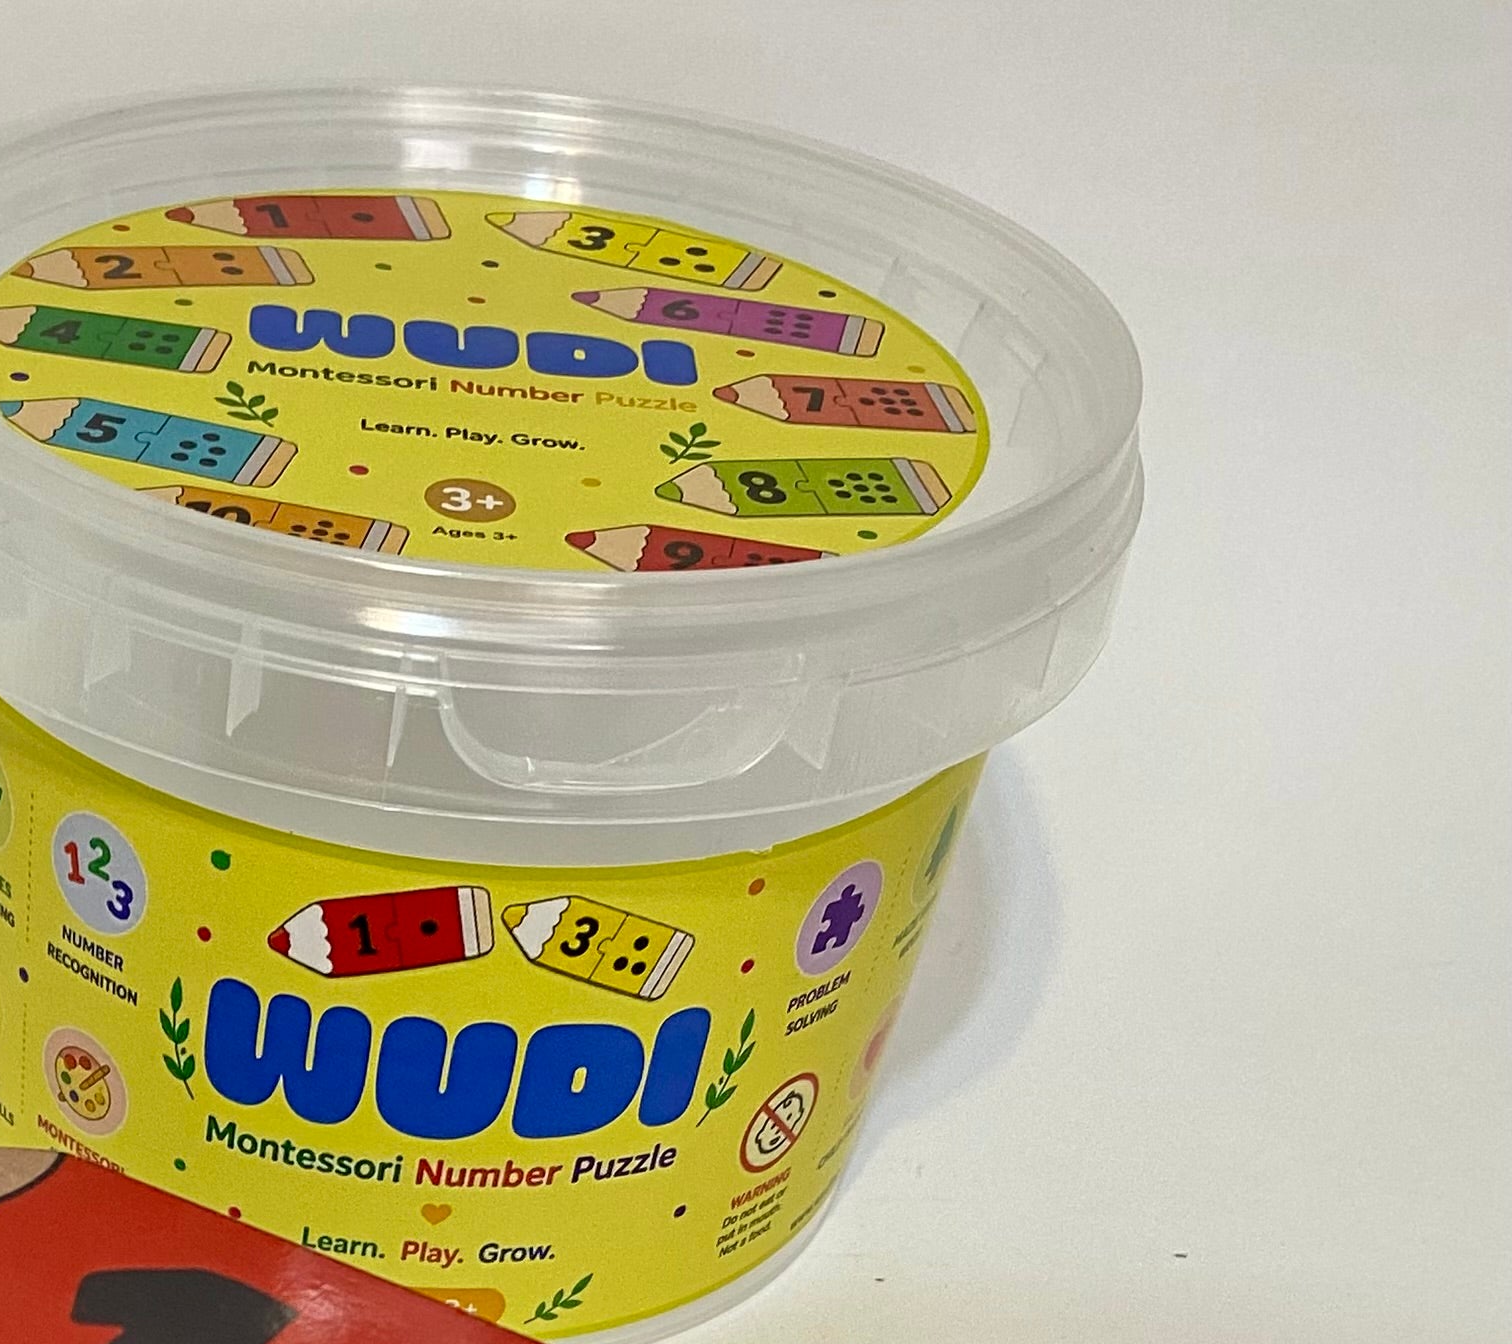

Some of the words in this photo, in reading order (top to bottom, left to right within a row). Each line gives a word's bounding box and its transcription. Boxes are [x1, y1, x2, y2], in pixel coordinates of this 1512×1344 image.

[255, 204, 288, 228] 1
[567, 226, 616, 251] 3
[94, 254, 142, 280] 2
[662, 300, 700, 321] 6
[39, 320, 83, 345] 4
[249, 304, 698, 386] WUDI
[247, 359, 438, 392] Montessori
[450, 379, 585, 404] Number
[595, 391, 698, 414] Puzzle
[791, 386, 824, 412] 7
[76, 413, 127, 444] 5
[361, 418, 438, 438] Learn.
[445, 426, 504, 446] Play.
[511, 433, 586, 451] Grow.
[441, 486, 504, 512] 3+
[737, 471, 787, 505] 8
[432, 526, 486, 539] Ages
[493, 531, 518, 541] 3+
[663, 540, 704, 568] 9
[61, 925, 124, 972] NUMBER
[347, 914, 377, 957] 1
[560, 916, 600, 959] 3
[47, 941, 138, 1007] RECOGNITION
[787, 971, 852, 1014] PROBLEM
[785, 1000, 838, 1036] SOLVING
[204, 978, 712, 1141] WUDI
[204, 1115, 403, 1183] Montessori
[414, 1157, 562, 1188] Number
[572, 1143, 678, 1184] Puzzle
[721, 1215, 738, 1229] Do
[739, 1204, 758, 1221] not
[301, 1226, 385, 1259] Learn.
[401, 1239, 464, 1269] Play.
[478, 1242, 556, 1264] Grow.
[716, 1228, 735, 1247] put
